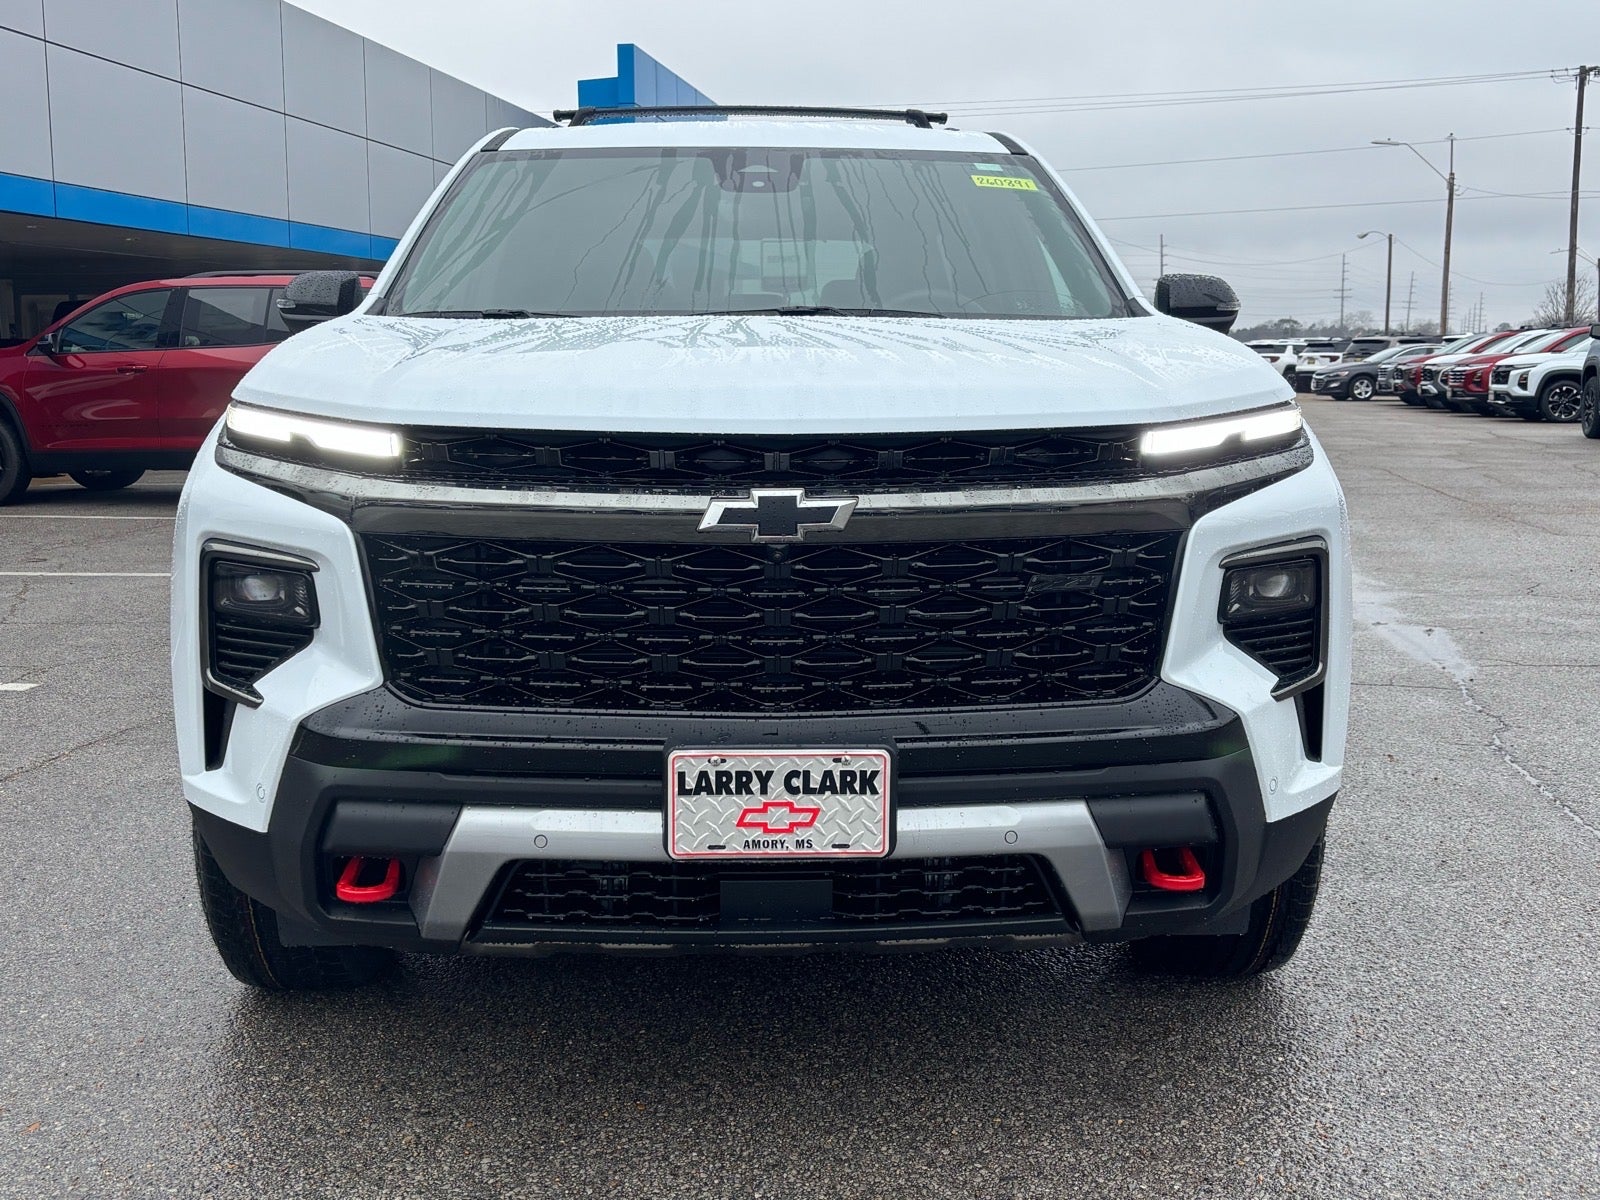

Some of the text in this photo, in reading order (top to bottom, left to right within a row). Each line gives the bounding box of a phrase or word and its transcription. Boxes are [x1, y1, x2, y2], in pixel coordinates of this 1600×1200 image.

[677, 769, 880, 796] LARRY CLARK
[743, 839, 813, 850] AMORY, MS
